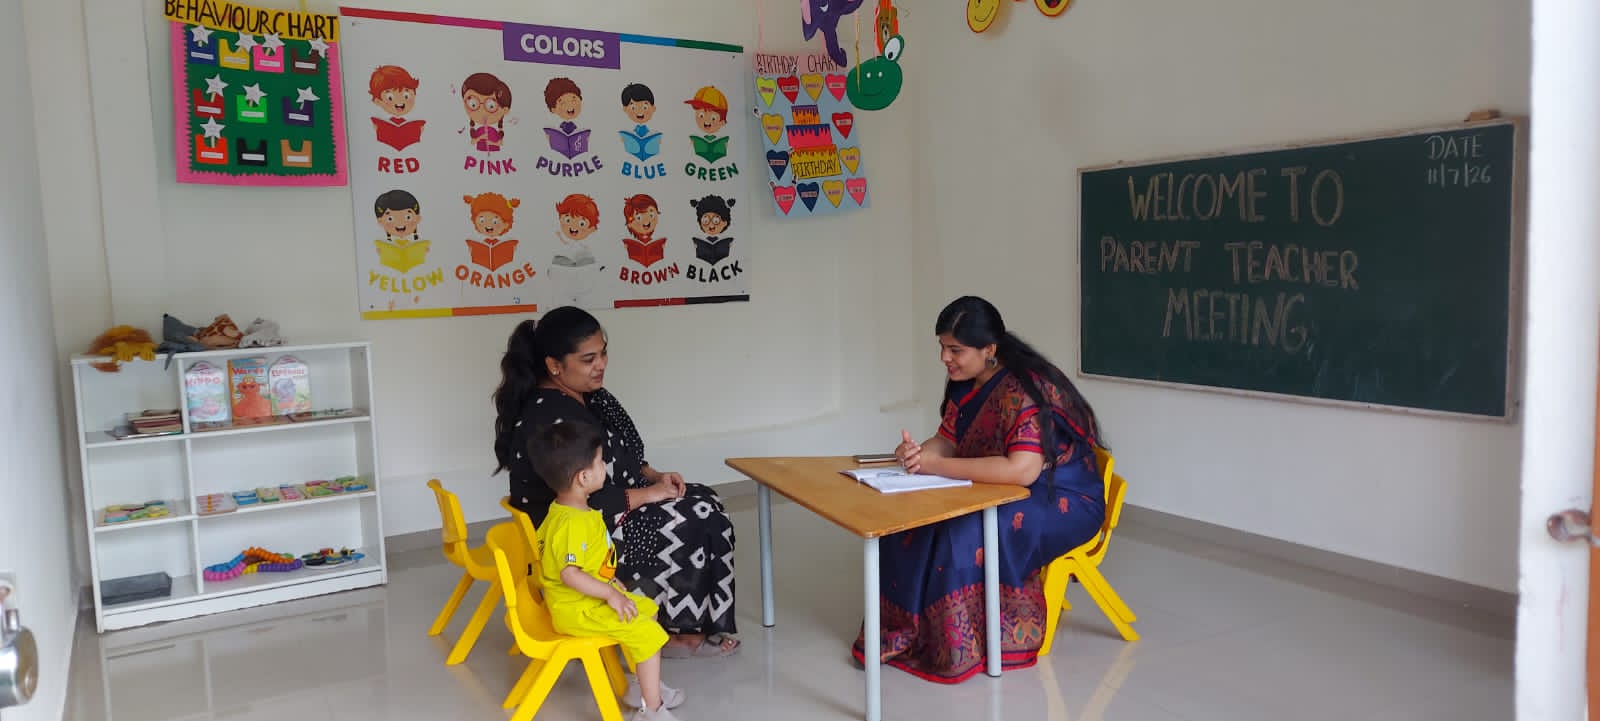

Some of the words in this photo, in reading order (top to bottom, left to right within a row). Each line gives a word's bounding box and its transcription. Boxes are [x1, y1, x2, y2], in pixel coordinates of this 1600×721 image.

[164, 0, 273, 35] BEHAVIOUR
[273, 12, 338, 40] CHART
[520, 33, 606, 59] COLORS
[1424, 135, 1484, 160] DATE
[378, 156, 420, 174] RED
[464, 156, 517, 175] PINK
[536, 155, 603, 177] PURPLE
[621, 161, 667, 180] BLUE
[684, 162, 739, 181] GREEN
[792, 158, 838, 177] BIRTHDAY
[1127, 168, 1268, 223] WELCOME
[1281, 165, 1345, 227] TO
[619, 262, 680, 285] BROWN
[686, 260, 743, 283] BLACK
[1100, 236, 1201, 275] PARENT
[1223, 240, 1360, 291] TEACHER
[369, 266, 444, 294] YELLOW
[455, 263, 536, 289] ORANGE
[1163, 287, 1309, 354] MEETING
